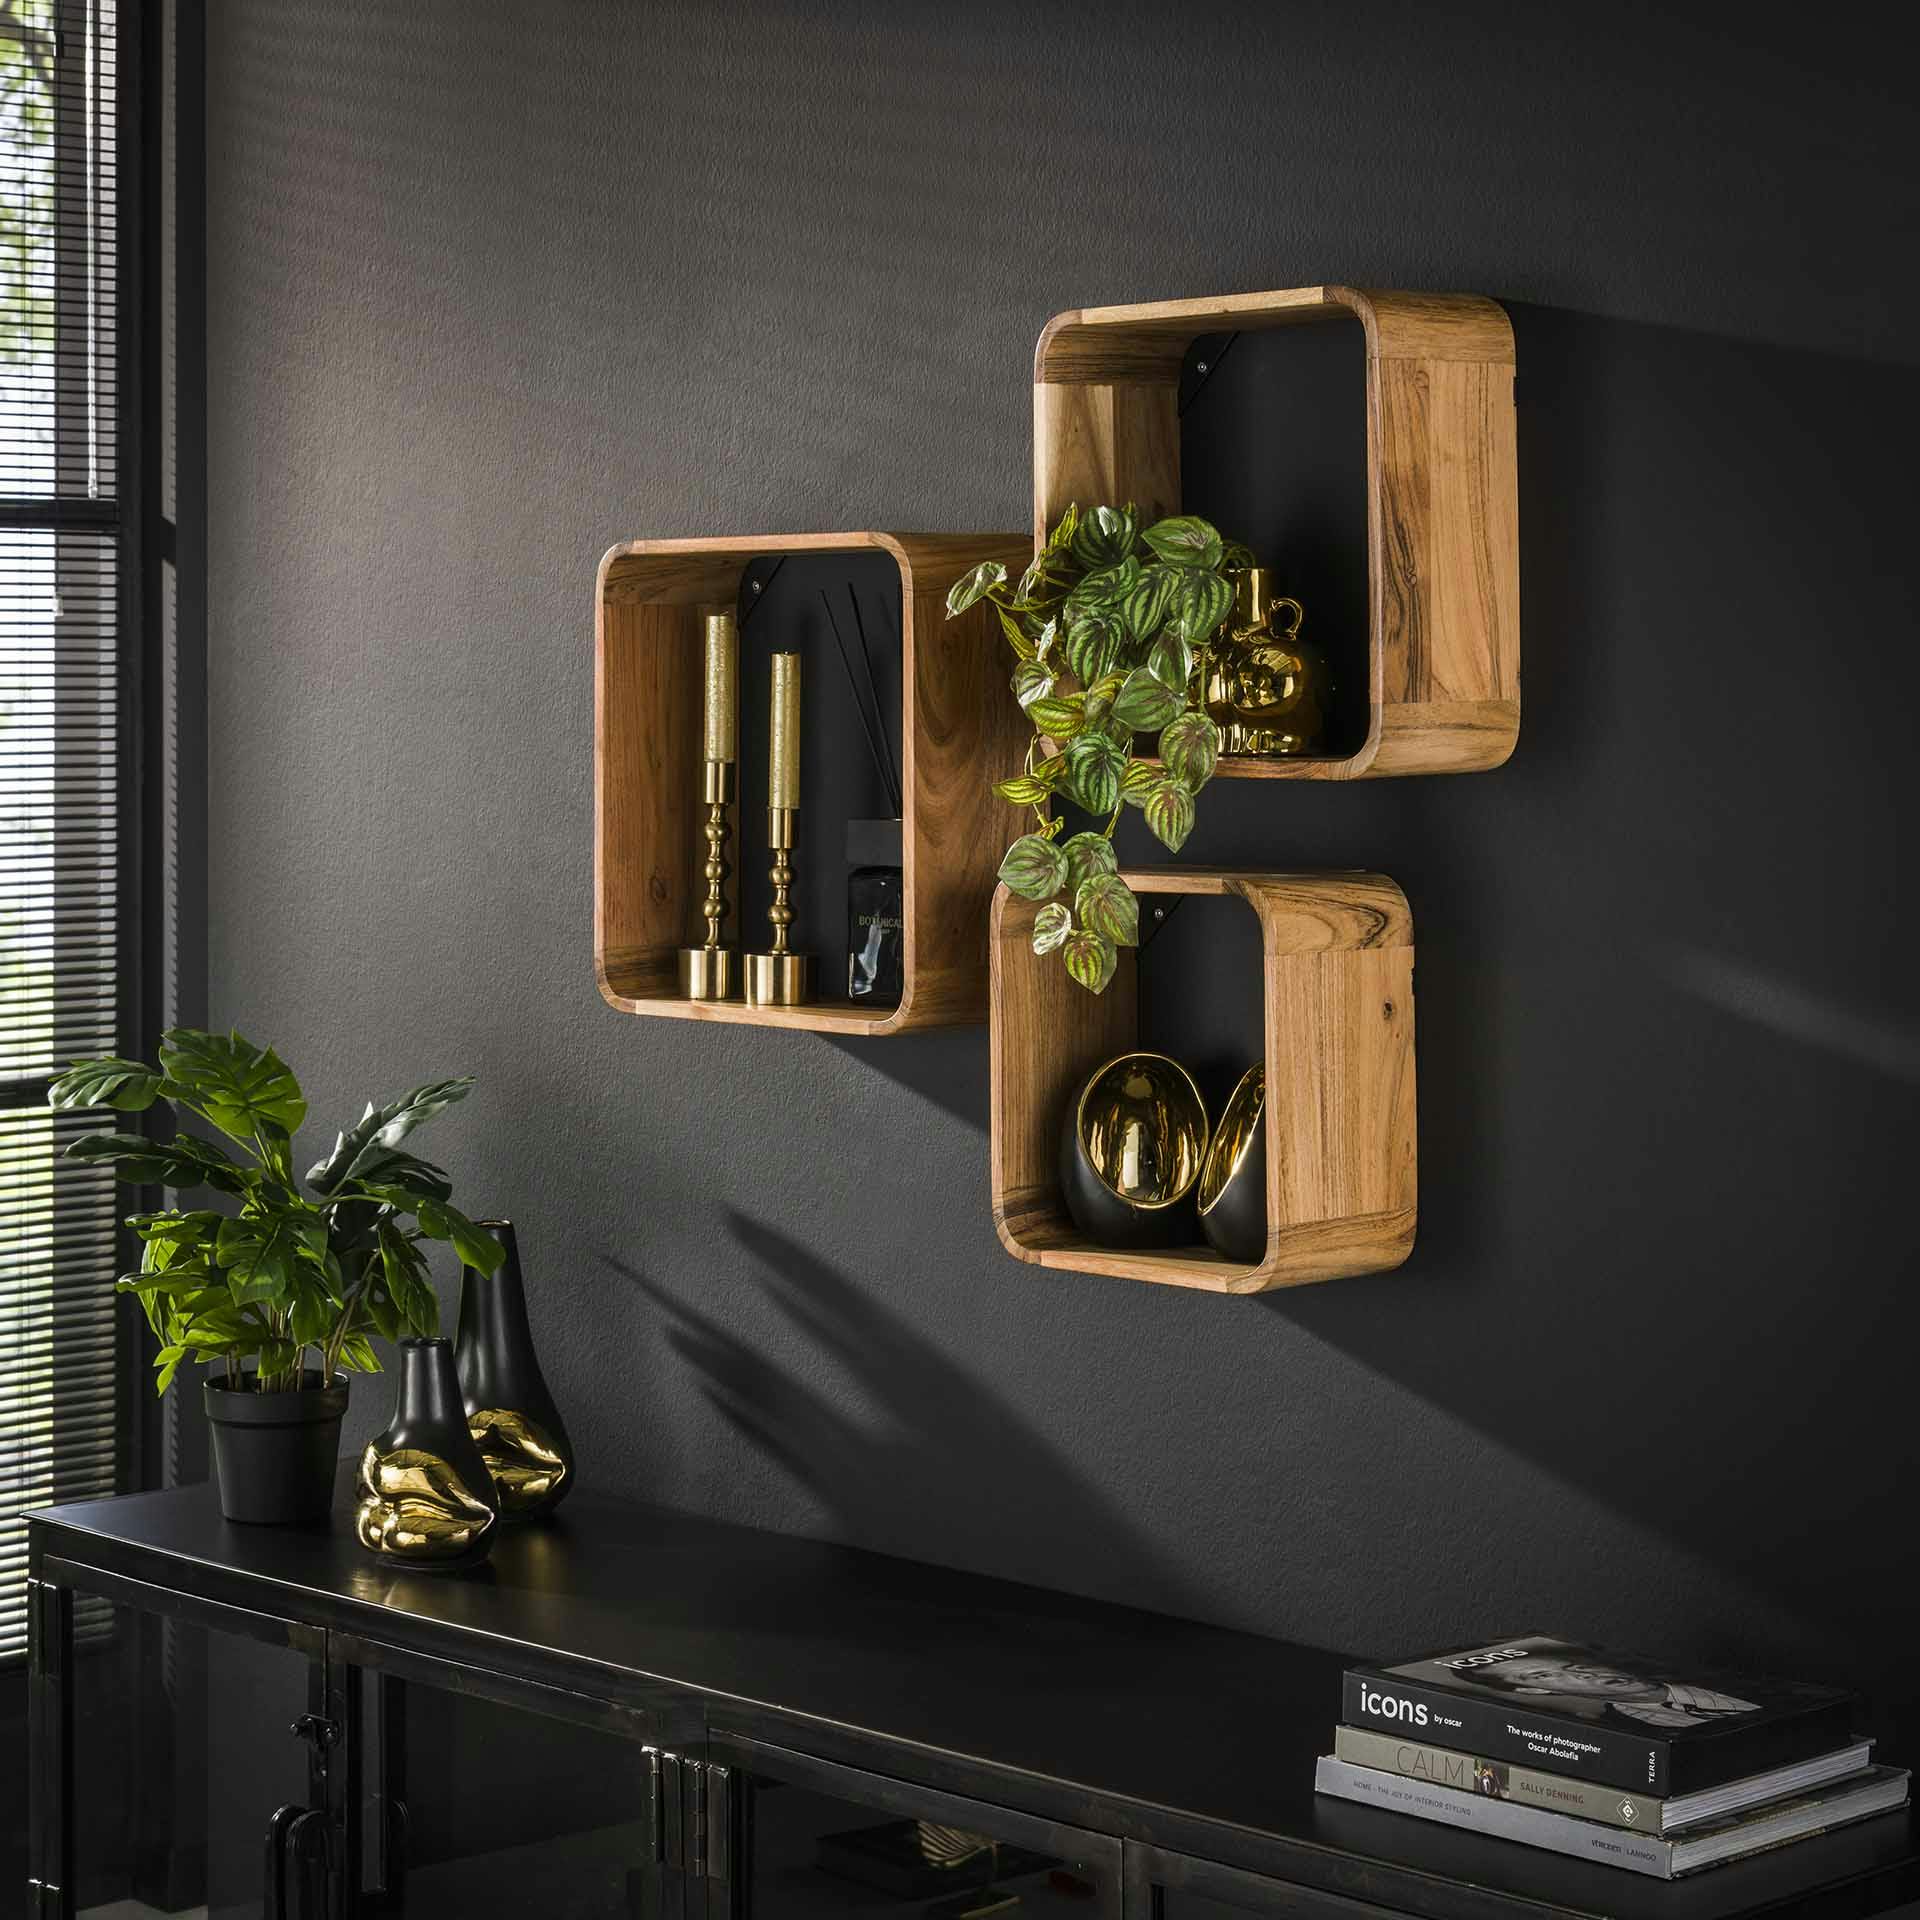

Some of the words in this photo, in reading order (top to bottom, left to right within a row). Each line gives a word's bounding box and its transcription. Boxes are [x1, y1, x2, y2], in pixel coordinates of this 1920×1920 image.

[1434, 1649, 1528, 1670] icons
[1361, 1682, 1428, 1726] icons
[1434, 1714, 1443, 1725] by
[1444, 1717, 1462, 1728] oscar
[1506, 1724, 1520, 1736] The
[1522, 1730, 1543, 1741] works
[1544, 1734, 1552, 1743] of
[1553, 1737, 1601, 1754] photographer
[1528, 1742, 1548, 1754] Oscar
[1549, 1747, 1579, 1761] Abolafia
[1397, 1746, 1464, 1786] CALM
[1520, 1782, 1544, 1795] SALLY
[1545, 1788, 1584, 1804] DENNING
